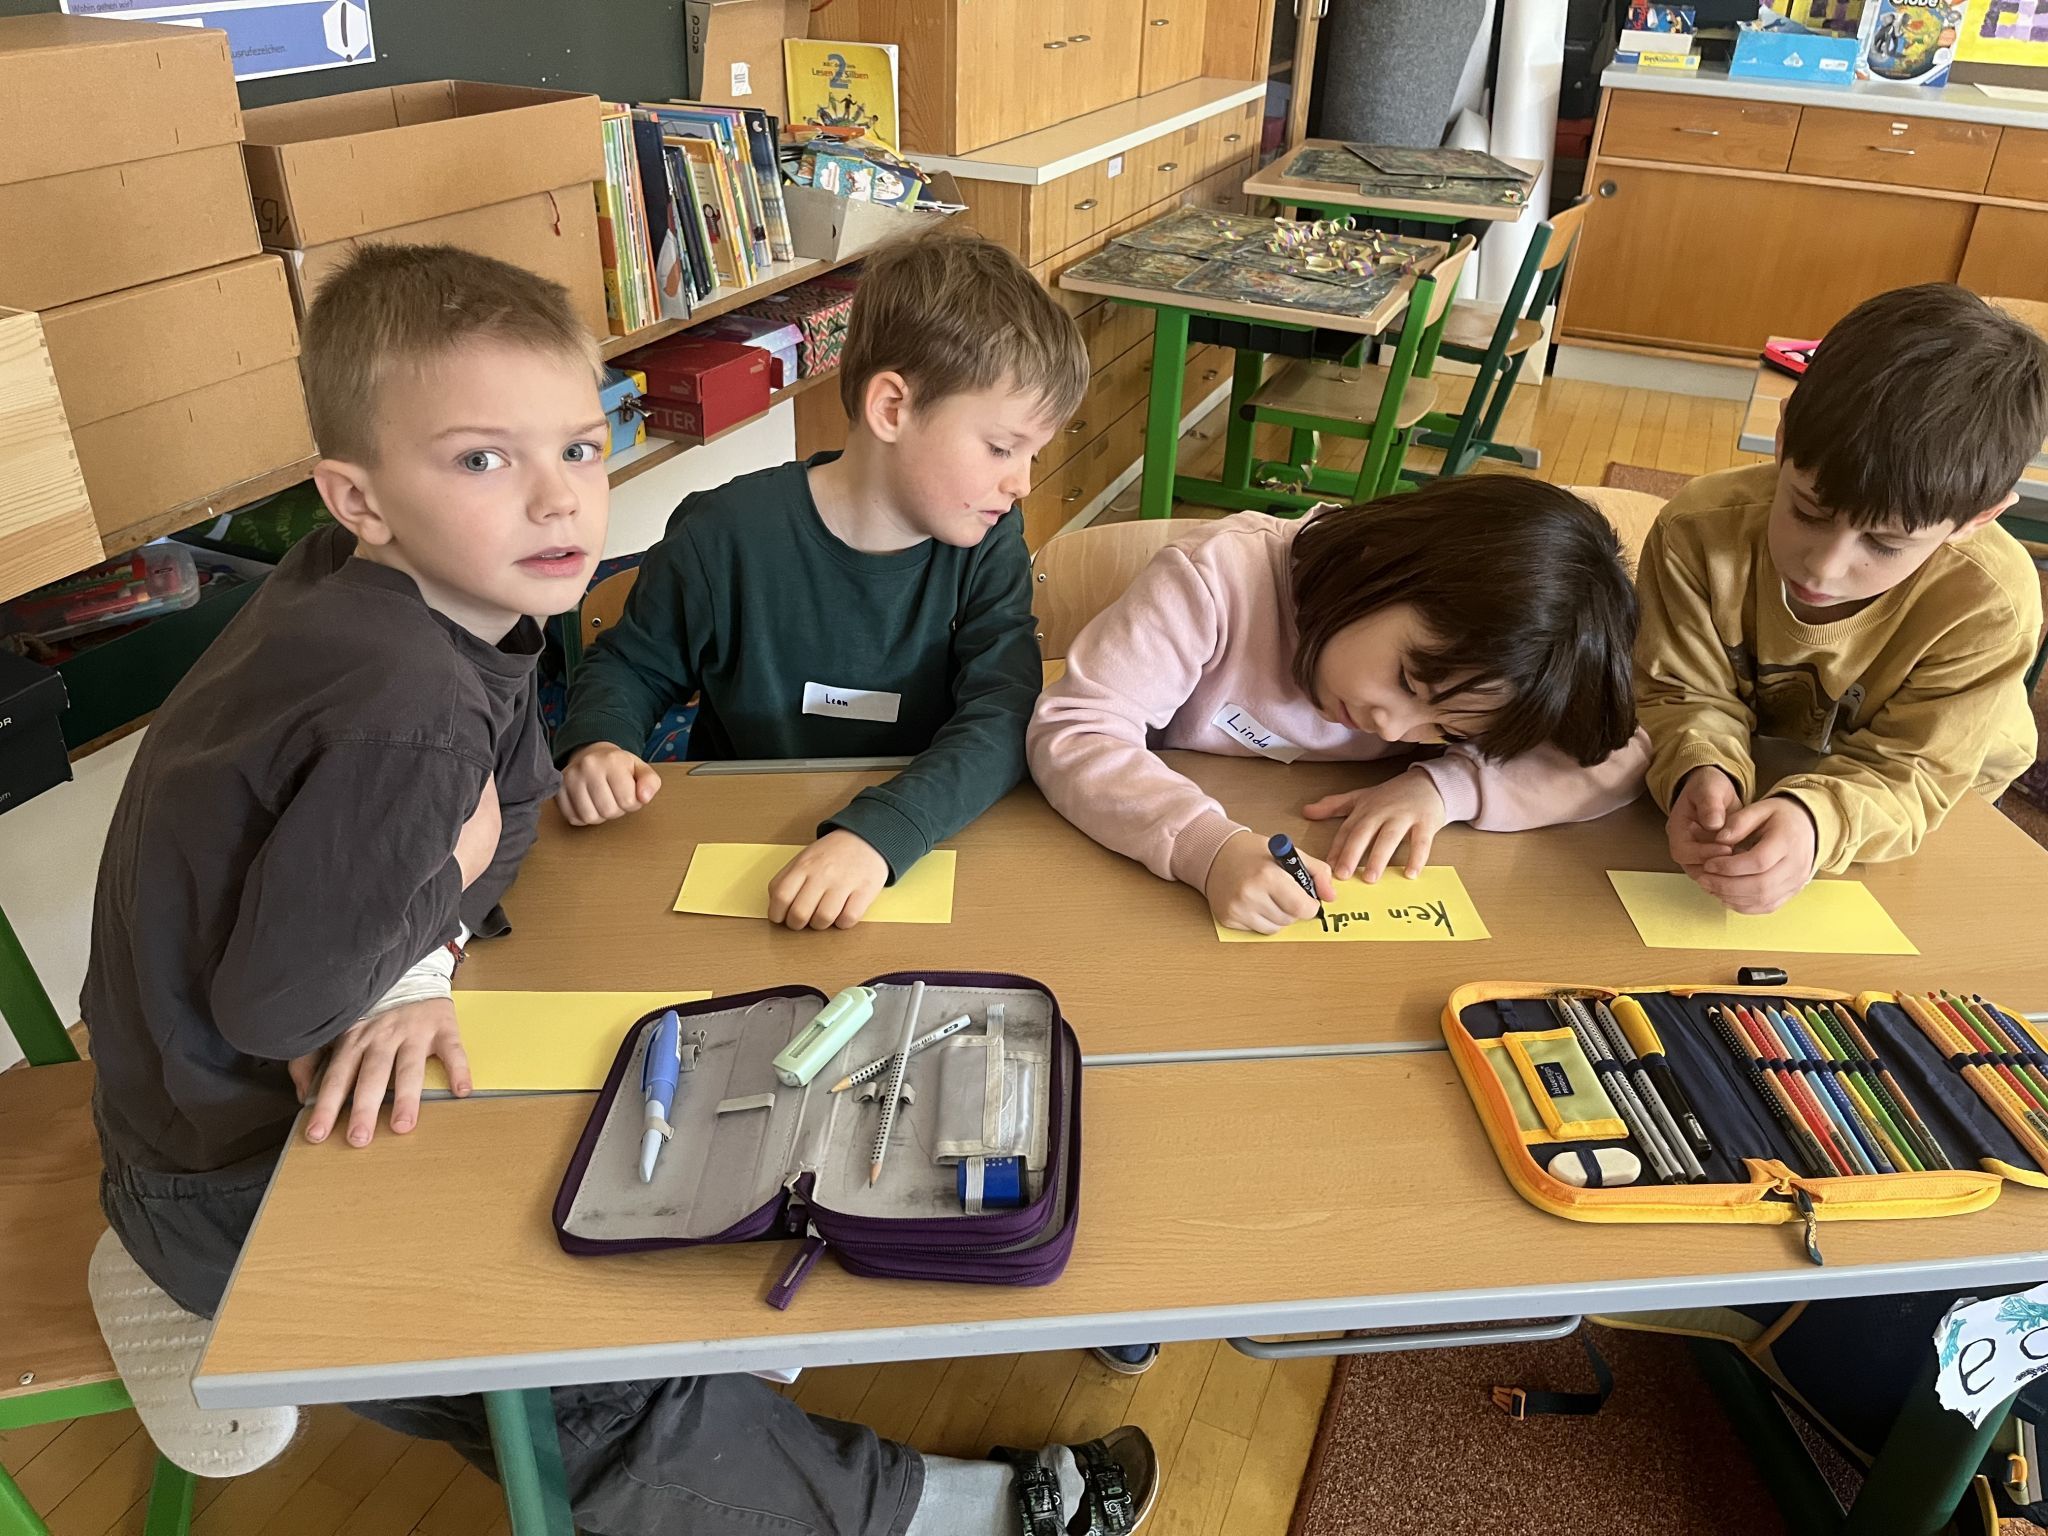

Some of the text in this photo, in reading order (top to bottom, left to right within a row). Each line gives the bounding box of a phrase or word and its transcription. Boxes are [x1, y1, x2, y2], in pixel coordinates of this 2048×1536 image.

[692, 15, 700, 54] ecco
[827, 53, 849, 90] 2
[1226, 712, 1271, 749] Linda
